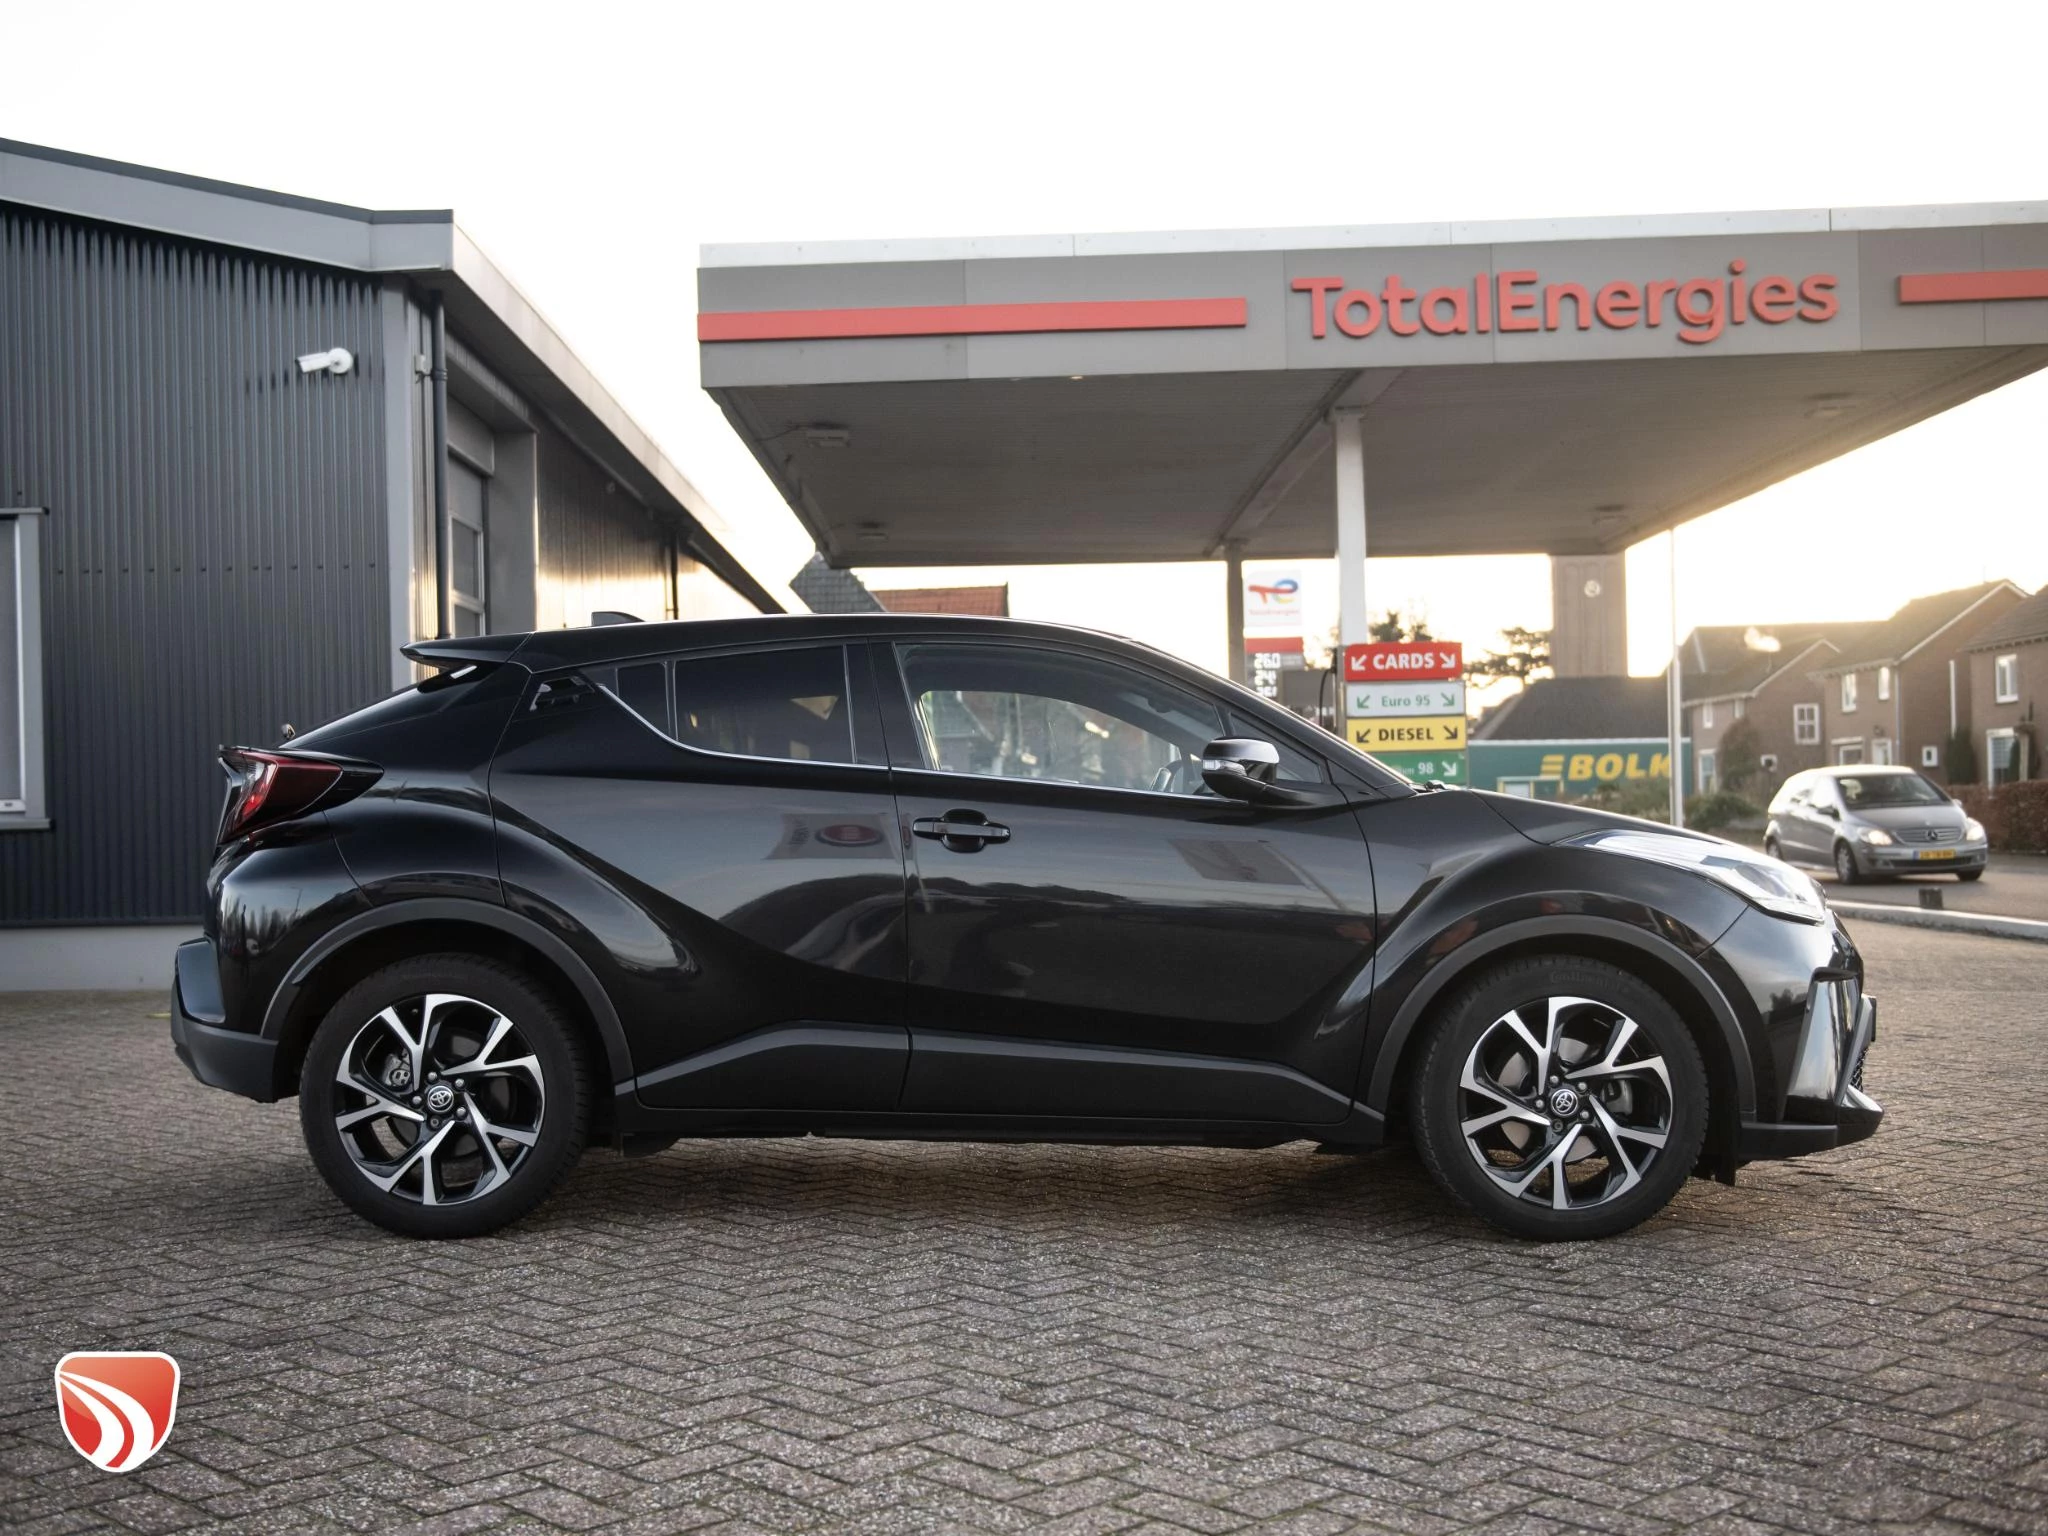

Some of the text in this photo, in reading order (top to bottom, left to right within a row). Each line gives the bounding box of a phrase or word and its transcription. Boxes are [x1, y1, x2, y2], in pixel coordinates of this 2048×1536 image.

[1291, 261, 1839, 344] TotalEnergies
[1372, 652, 1435, 670] CARDS
[1381, 694, 1431, 708] Euro 95
[1378, 728, 1434, 741] DIESEL
[1417, 761, 1434, 775] 98
